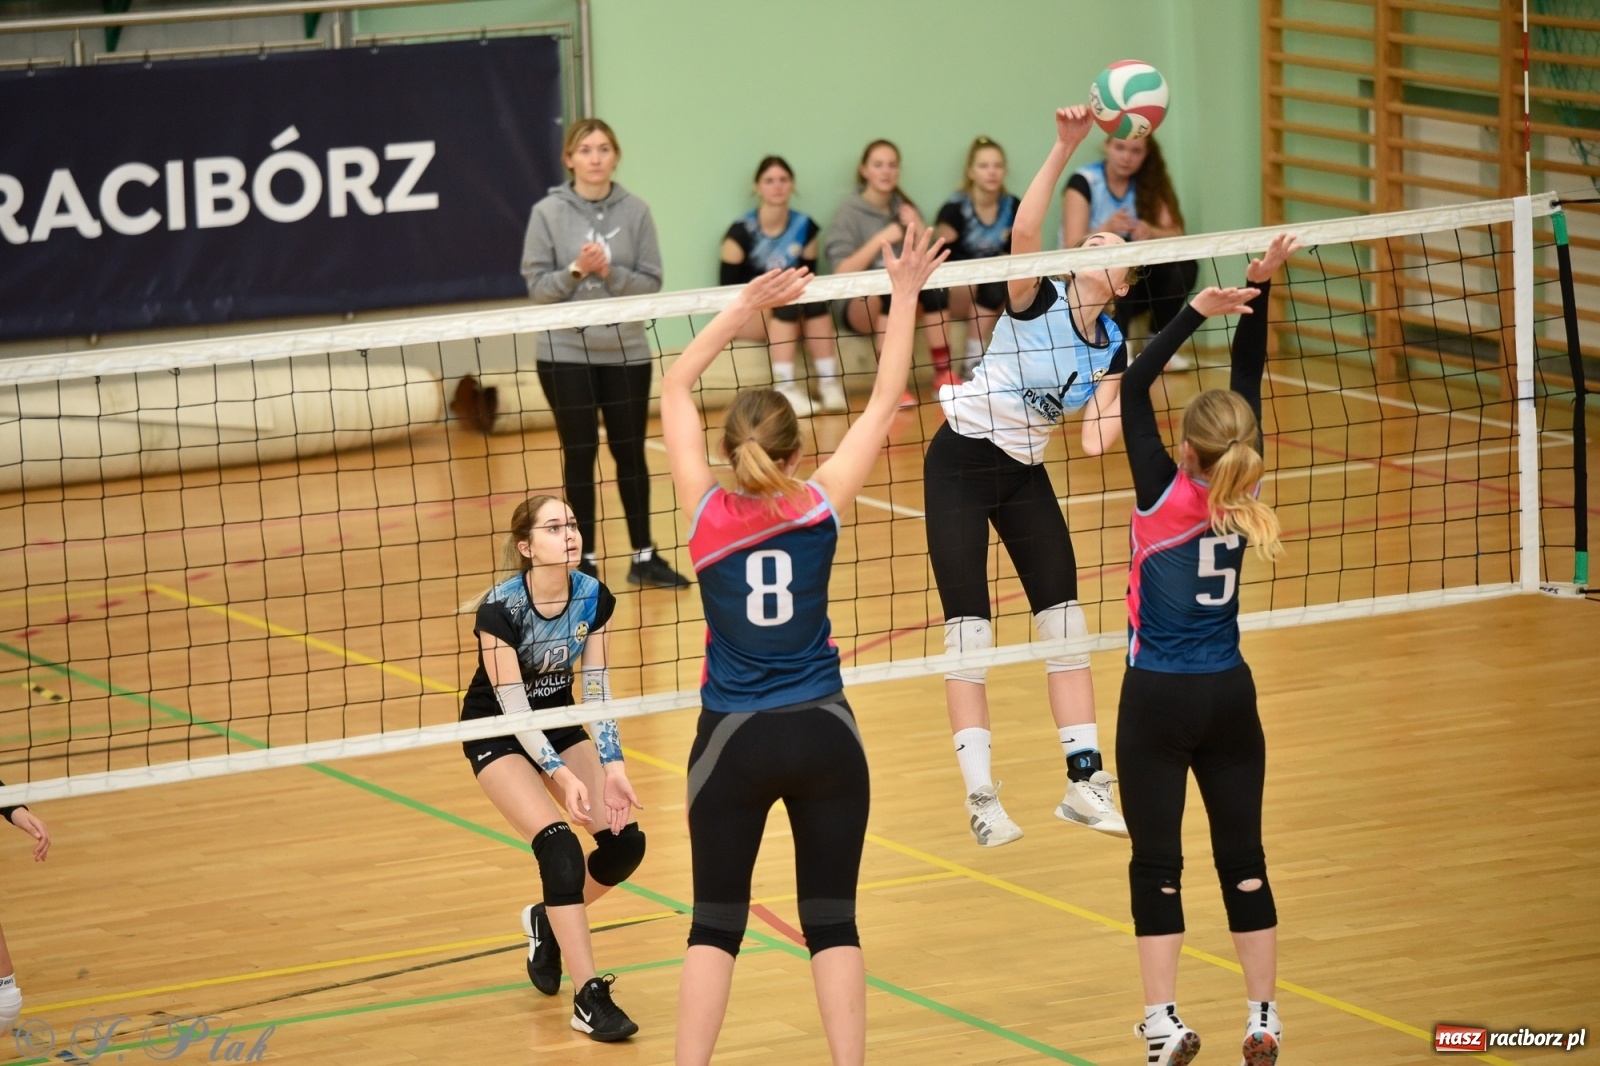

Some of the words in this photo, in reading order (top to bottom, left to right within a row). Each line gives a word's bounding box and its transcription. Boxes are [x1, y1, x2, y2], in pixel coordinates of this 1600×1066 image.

[745, 549, 794, 627] 8
[1195, 533, 1239, 606] 5
[538, 645, 569, 674] 12
